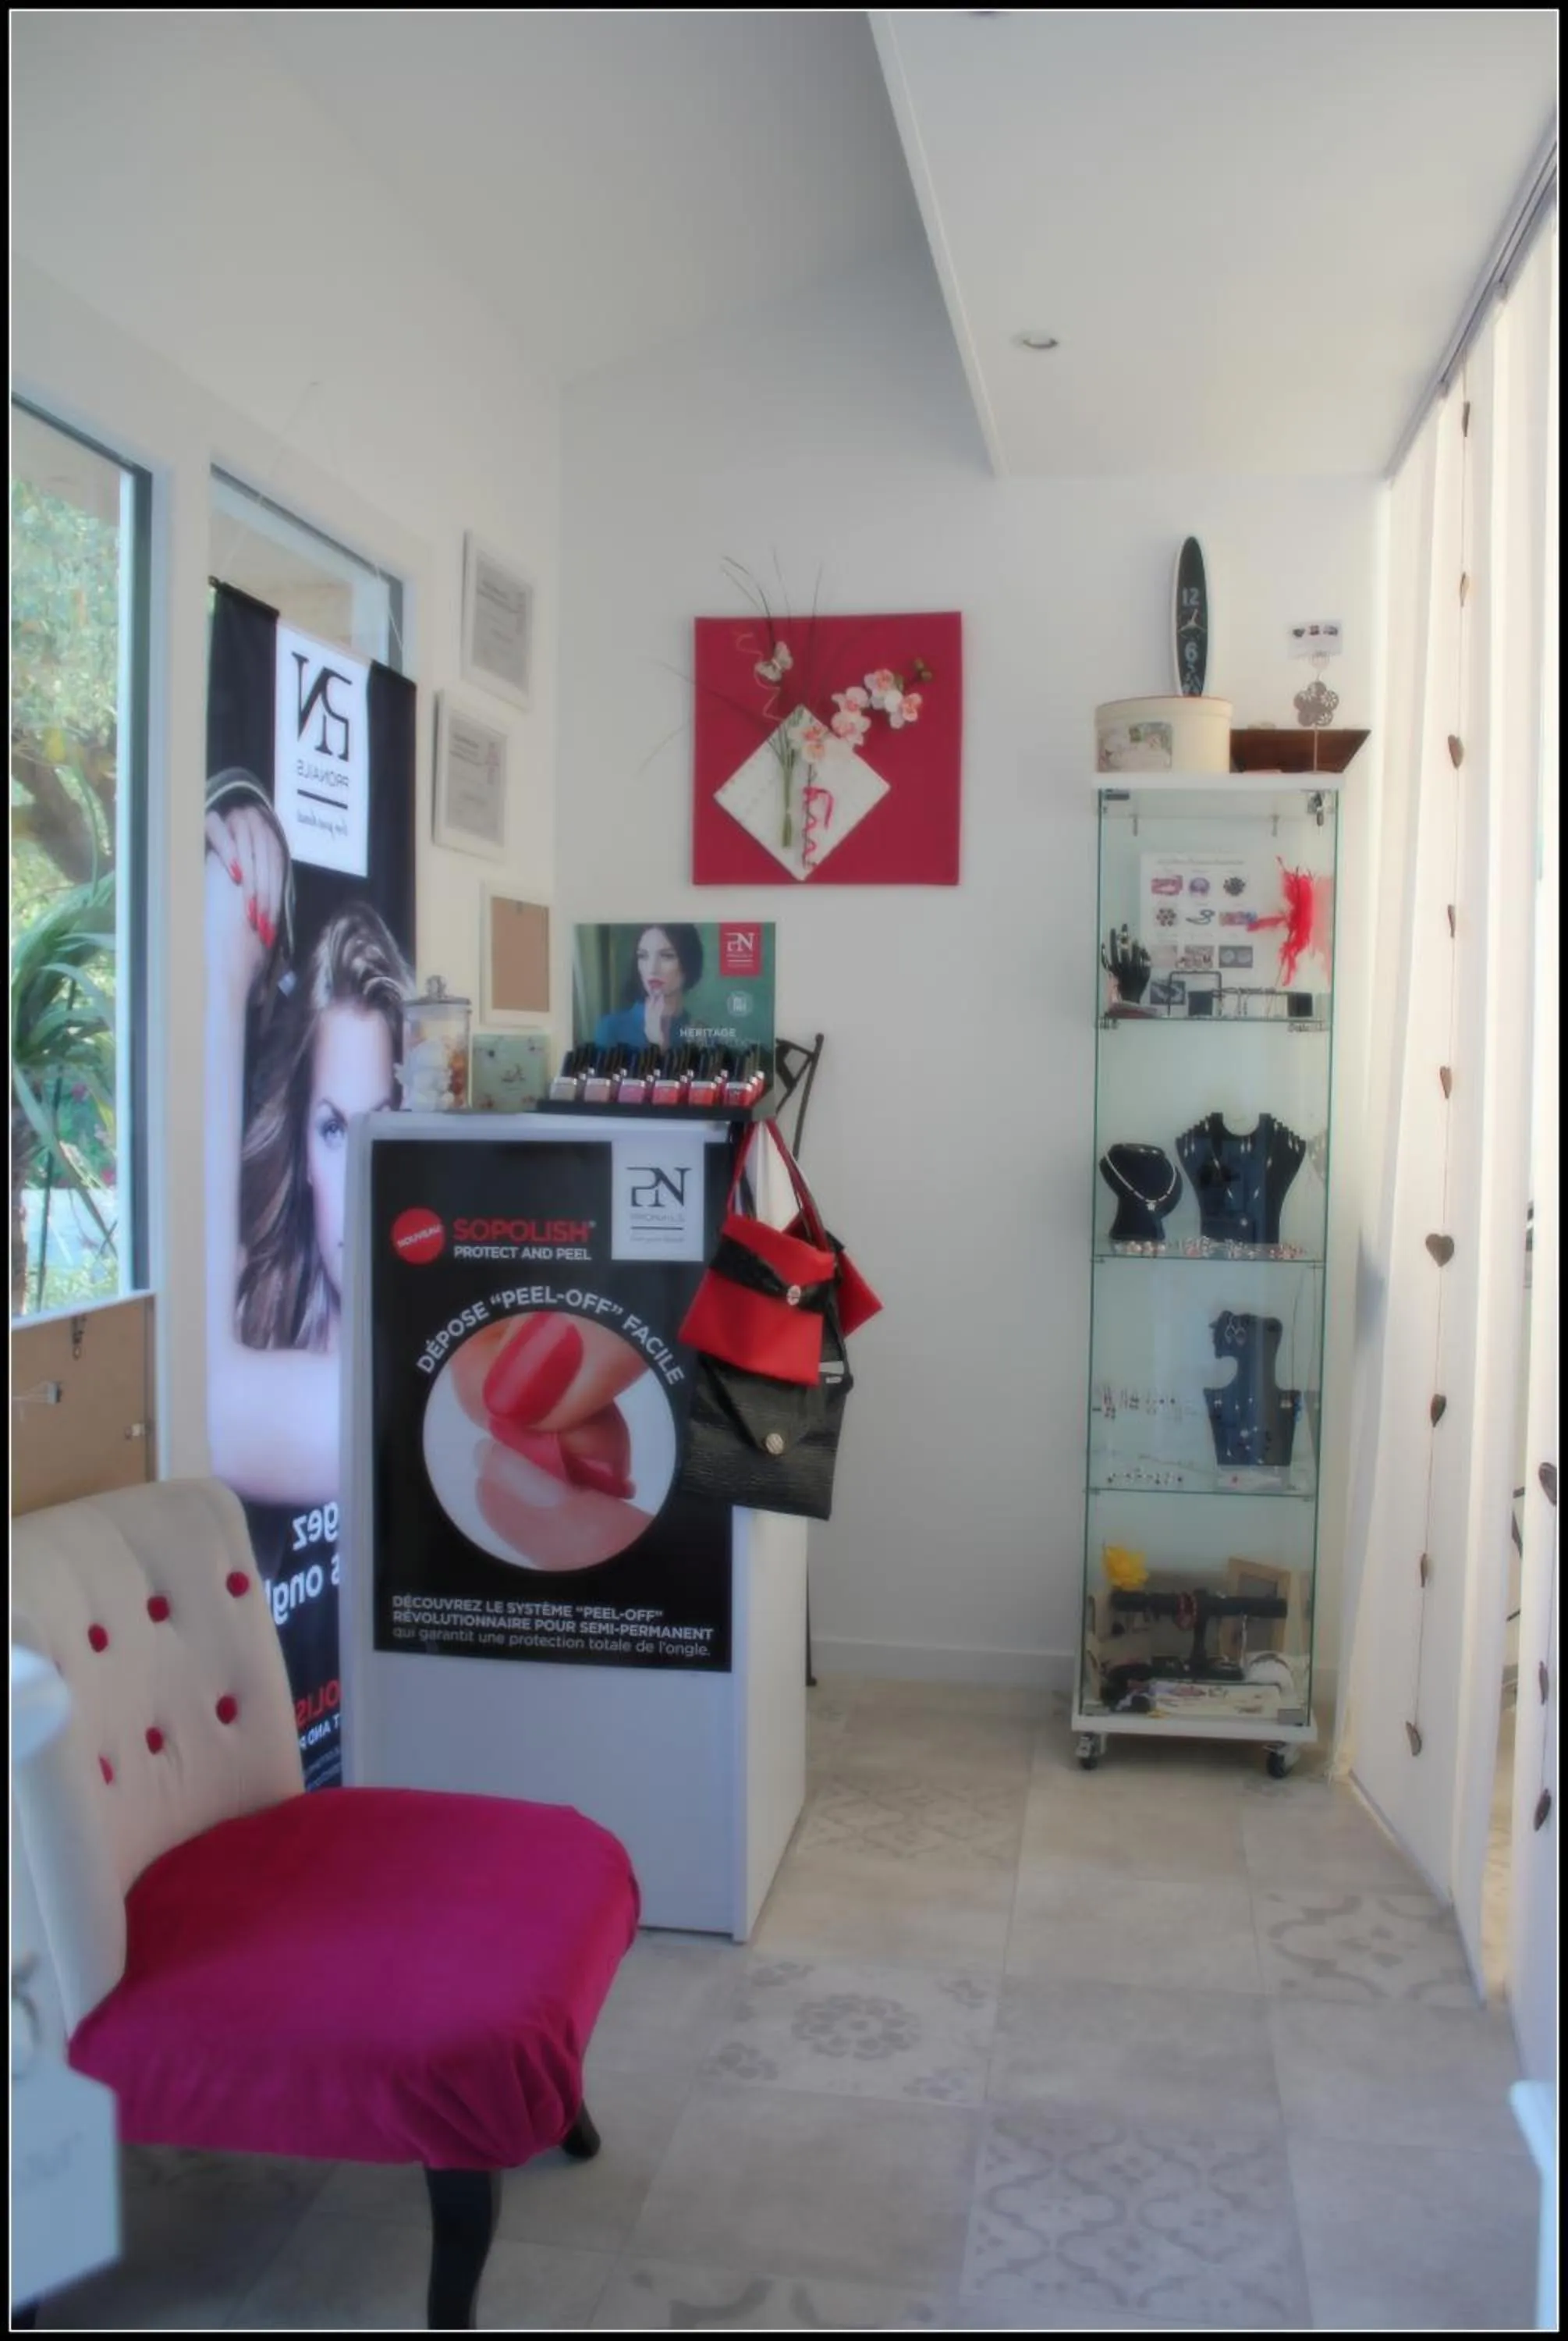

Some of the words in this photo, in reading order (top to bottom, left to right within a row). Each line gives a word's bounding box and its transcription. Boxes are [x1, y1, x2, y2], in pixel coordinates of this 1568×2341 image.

[1181, 587, 1199, 606] 12
[1184, 641, 1197, 663] 6
[679, 1027, 736, 1038] HERITAGE
[626, 1167, 692, 1208] PN
[453, 1245, 519, 1259] PROTECT
[521, 1246, 554, 1260] AND
[556, 1248, 592, 1261] PEEL
[416, 1301, 490, 1374] DÉPOSE
[622, 1313, 686, 1385] FACILE
[392, 1593, 482, 1612] DÉCOUVREZ
[486, 1600, 504, 1614] LE
[506, 1600, 573, 1618] SYSTÈME
[392, 1608, 531, 1630] RÉVOLUTIONNAIRE
[534, 1618, 576, 1633] POUR
[580, 1620, 715, 1641] SEMI-PERMANENT
[392, 1625, 417, 1639] qui
[418, 1627, 475, 1642] garantit
[478, 1632, 505, 1645] une
[509, 1634, 584, 1650] protection
[589, 1638, 631, 1654] totale
[636, 1640, 655, 1654] de
